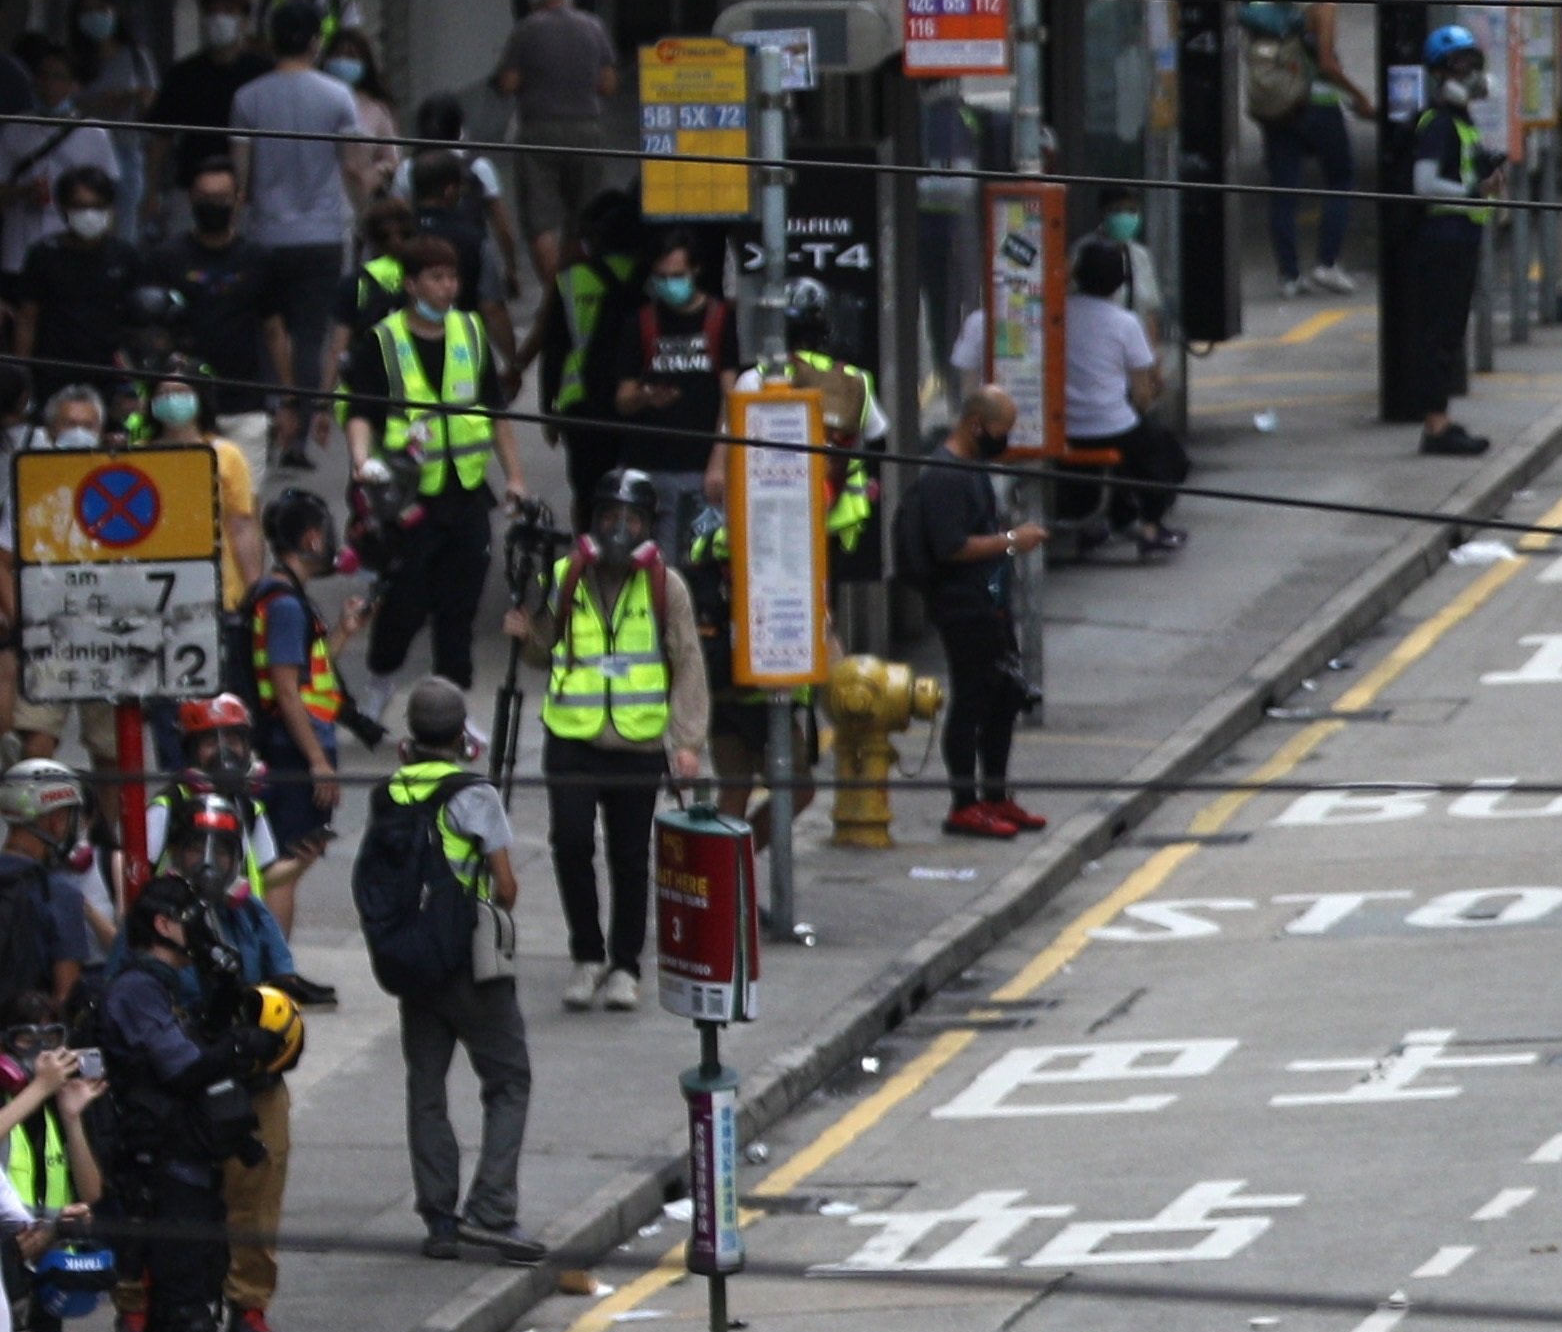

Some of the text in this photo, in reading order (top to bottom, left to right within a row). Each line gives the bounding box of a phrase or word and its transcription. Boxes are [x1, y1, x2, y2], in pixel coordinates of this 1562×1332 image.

[908, 18, 935, 38] 116
[643, 105, 740, 128] 5B 5X 72
[643, 134, 673, 155] 72A
[55, 591, 111, 617] 上午
[64, 570, 176, 613] am 7
[157, 644, 207, 688] 12
[930, 1029, 1537, 1119] 巴士
[844, 1180, 1304, 1272] 站
